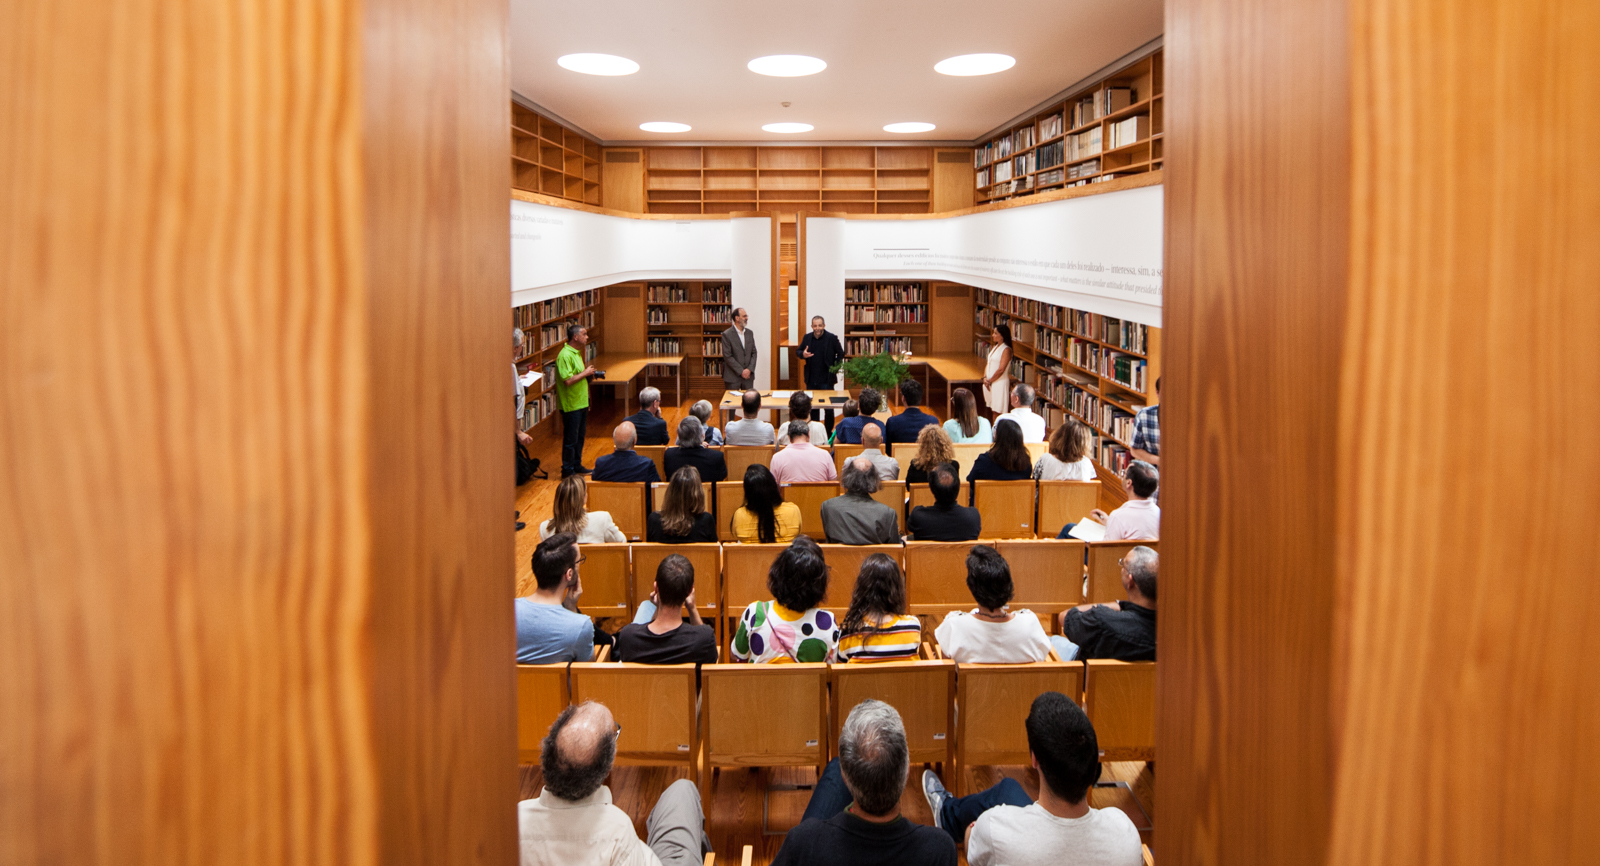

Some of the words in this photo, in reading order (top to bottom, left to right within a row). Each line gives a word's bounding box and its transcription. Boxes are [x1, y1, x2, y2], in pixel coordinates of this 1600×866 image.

[1084, 262, 1104, 273] realizado
[1111, 264, 1136, 276] interessa,
[1138, 265, 1150, 277] sim,
[1152, 268, 1156, 277] a
[1124, 280, 1135, 292] that
[1135, 283, 1158, 295] presided
